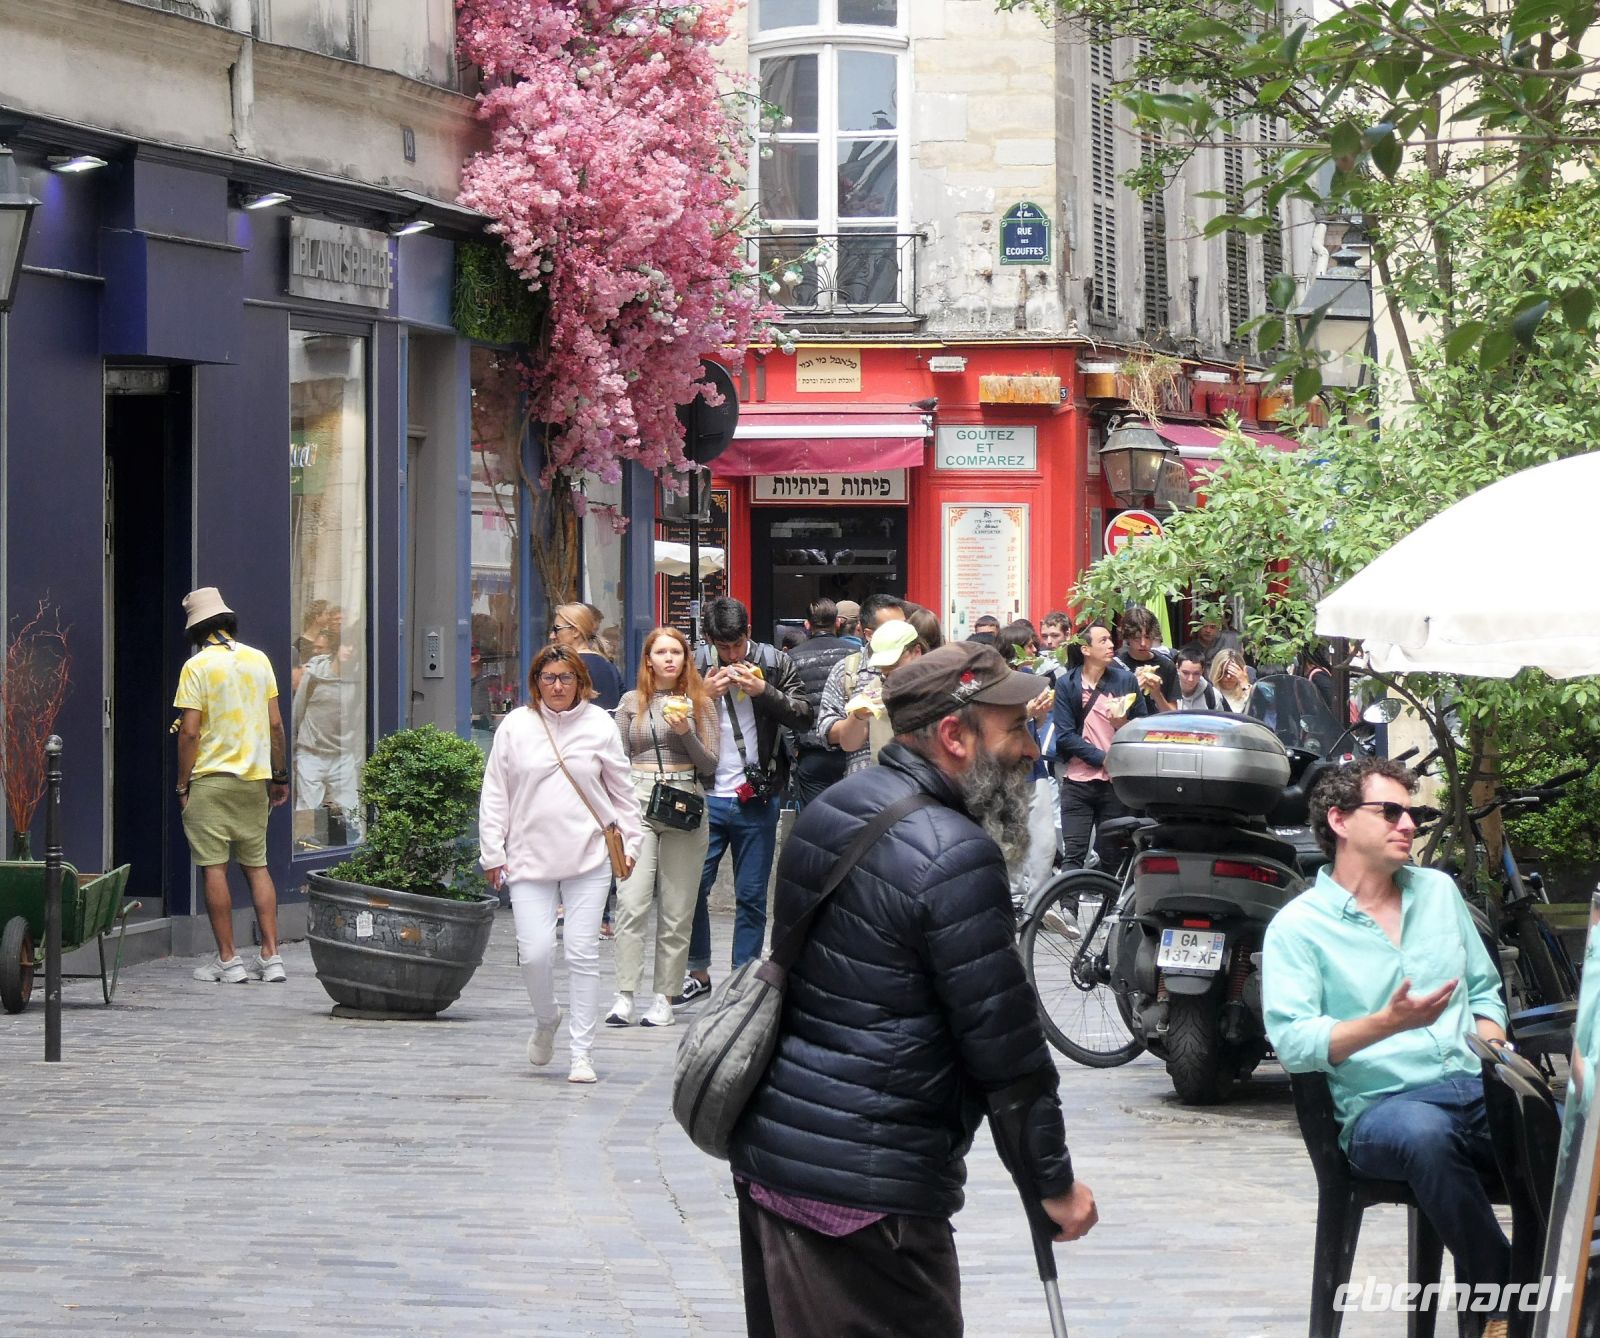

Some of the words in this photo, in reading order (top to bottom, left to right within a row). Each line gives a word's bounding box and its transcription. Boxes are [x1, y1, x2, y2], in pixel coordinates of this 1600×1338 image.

[1017, 227, 1032, 235] RUE
[1006, 247, 1044, 255] ECOUFFES
[298, 237, 393, 289] PLANISPHERE
[956, 430, 1015, 441] GOUTEZ
[976, 443, 994, 453] ET
[945, 455, 1025, 466] COMPAREZ
[772, 475, 830, 496] ביתיות
[841, 476, 891, 496] פיתות
[1181, 934, 1198, 947] GA
[1164, 949, 1218, 964] 137-XF
